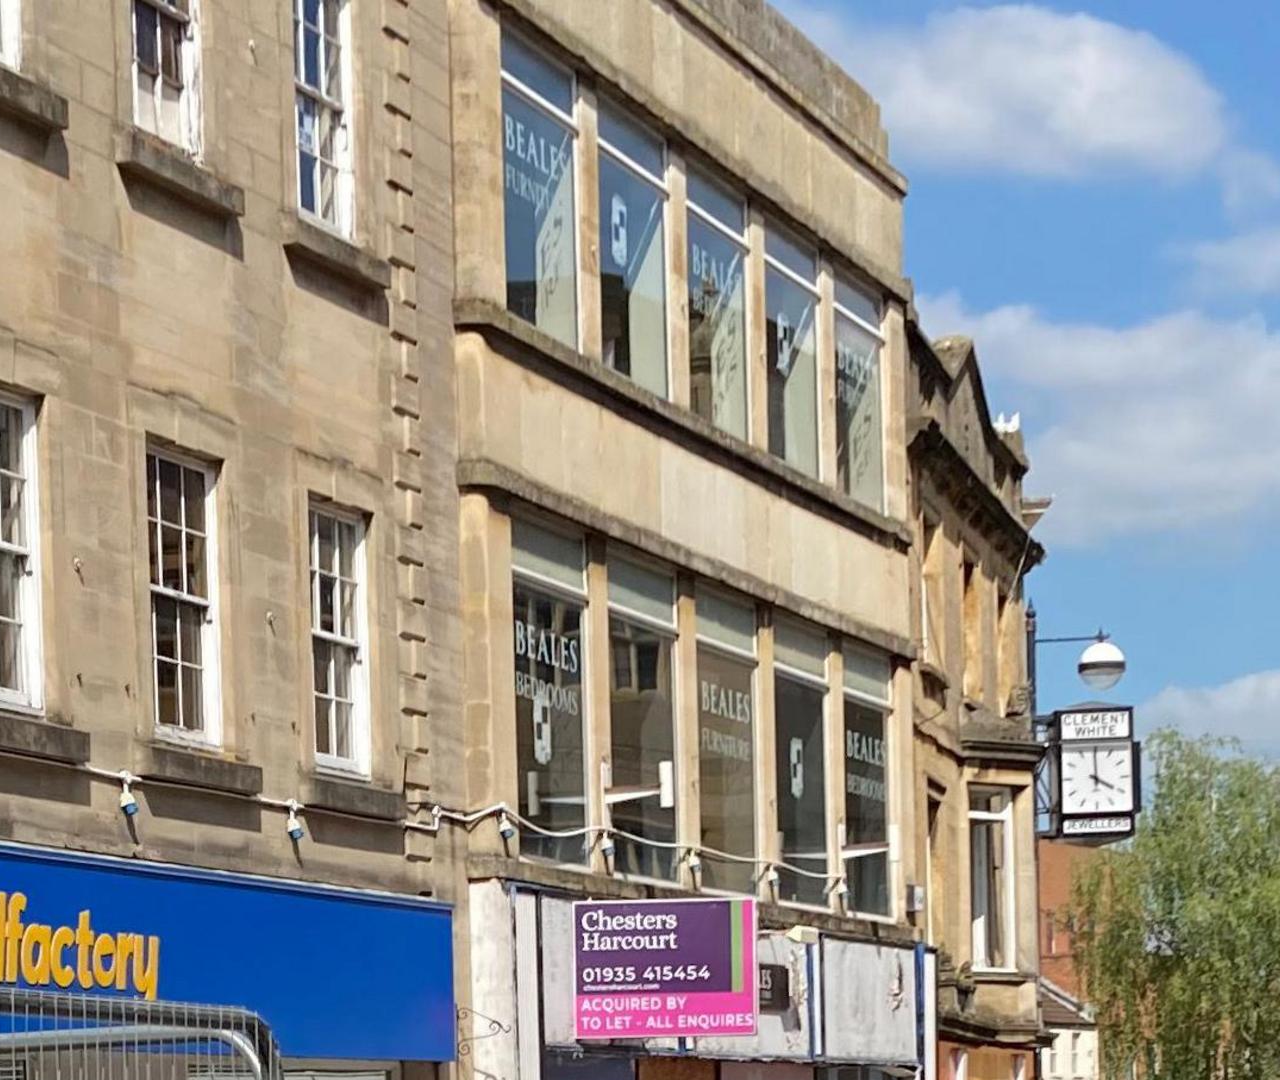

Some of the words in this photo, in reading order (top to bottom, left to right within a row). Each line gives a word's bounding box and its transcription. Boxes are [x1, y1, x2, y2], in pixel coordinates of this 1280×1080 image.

[515, 619, 578, 673] BEALES
[515, 670, 579, 716] BEDROOMS
[701, 680, 751, 725] BEALES
[1063, 712, 1126, 727] CLEMENT
[1074, 724, 1117, 737] WHITE
[581, 910, 678, 932] Chesters
[581, 931, 679, 951] Harcourt
[582, 966, 636, 983] 01935
[642, 965, 711, 981] 415454
[581, 996, 662, 1012] ACQUIRED
[666, 996, 688, 1010] BY
[581, 1016, 602, 1030] TO
[606, 1016, 631, 1030] LET
[646, 1014, 674, 1028] ALL
[678, 1012, 754, 1028] ENQUIRES
